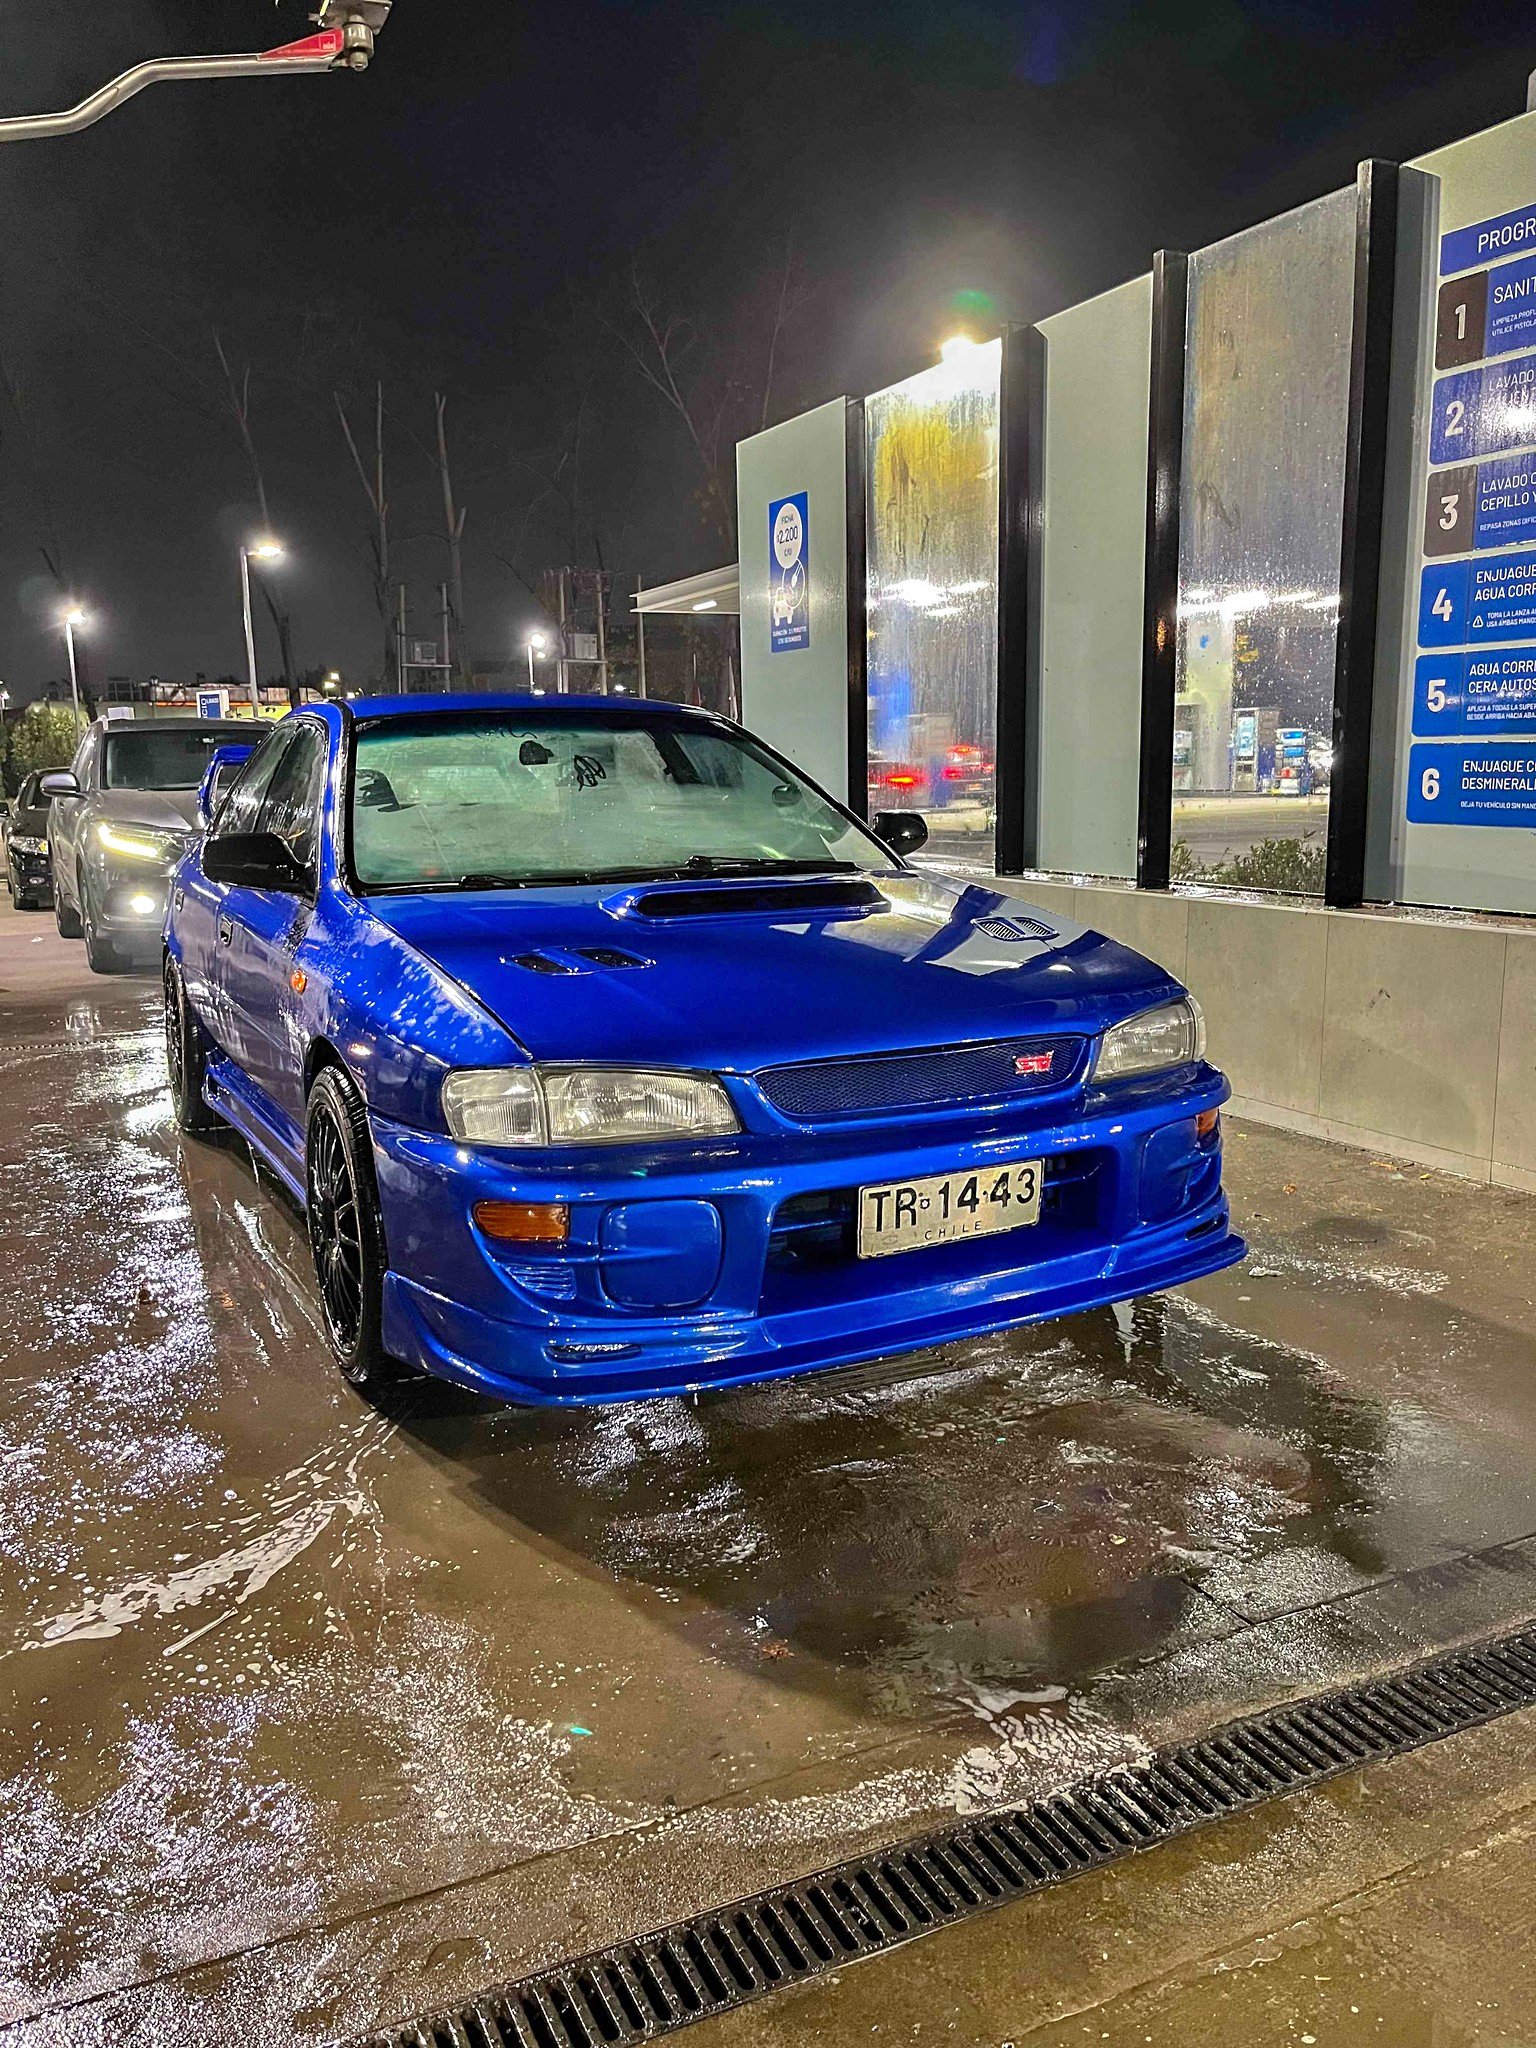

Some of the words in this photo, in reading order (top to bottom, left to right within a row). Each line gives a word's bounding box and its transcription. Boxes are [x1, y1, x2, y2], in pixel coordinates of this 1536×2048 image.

[1478, 217, 1536, 254] PROGR
[1493, 275, 1536, 304] SANIT
[1454, 303, 1467, 340] 1
[1491, 324, 1514, 337] UTILICE
[1488, 369, 1535, 392] LAVADO
[1444, 400, 1465, 438] 2
[1482, 473, 1528, 494] LAVADO
[1439, 494, 1459, 530] 3
[1481, 491, 1530, 512] CEPILLO
[1502, 518, 1522, 528] ZONAS
[1476, 563, 1536, 584] ENJUAGUE
[1474, 586, 1506, 602] AGUA
[1431, 588, 1453, 622] 4
[1503, 610, 1511, 618] LA
[1511, 608, 1531, 617] LANZA
[1486, 620, 1498, 628] USA
[1468, 662, 1500, 676] AGUA
[1427, 679, 1447, 713] 5
[1468, 680, 1499, 694] CERA
[1499, 678, 1536, 692] AUTOS
[1492, 703, 1510, 711] TODAS
[1505, 711, 1523, 719] HACIA
[1463, 760, 1525, 773] ENJUAGUE
[1421, 768, 1440, 801] 6
[1460, 800, 1475, 808] DEJA
[924, 1220, 982, 1241] CHILE
